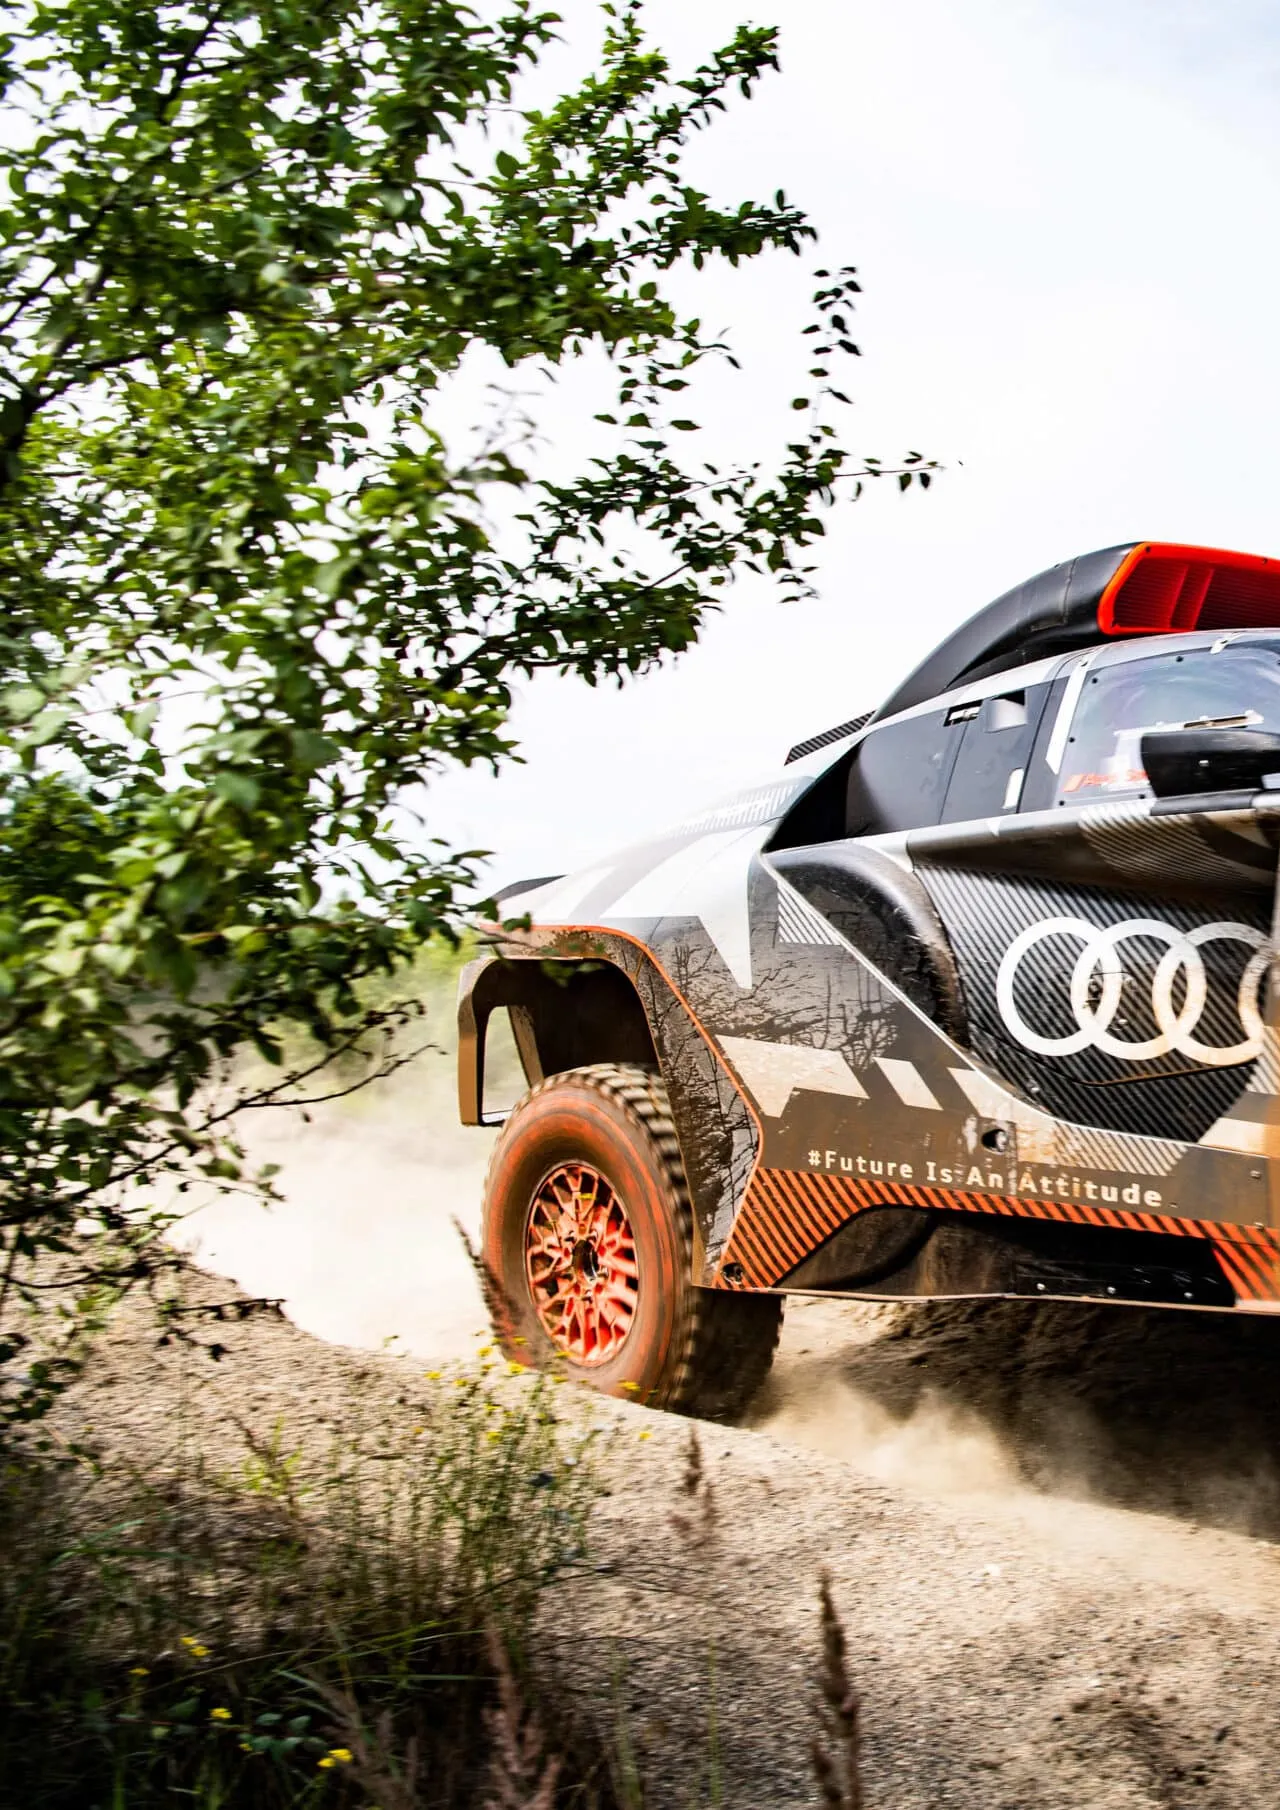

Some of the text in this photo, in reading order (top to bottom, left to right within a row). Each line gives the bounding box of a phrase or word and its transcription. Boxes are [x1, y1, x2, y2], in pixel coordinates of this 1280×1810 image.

[808, 1150, 1162, 1207] #Future Is An Attitude
